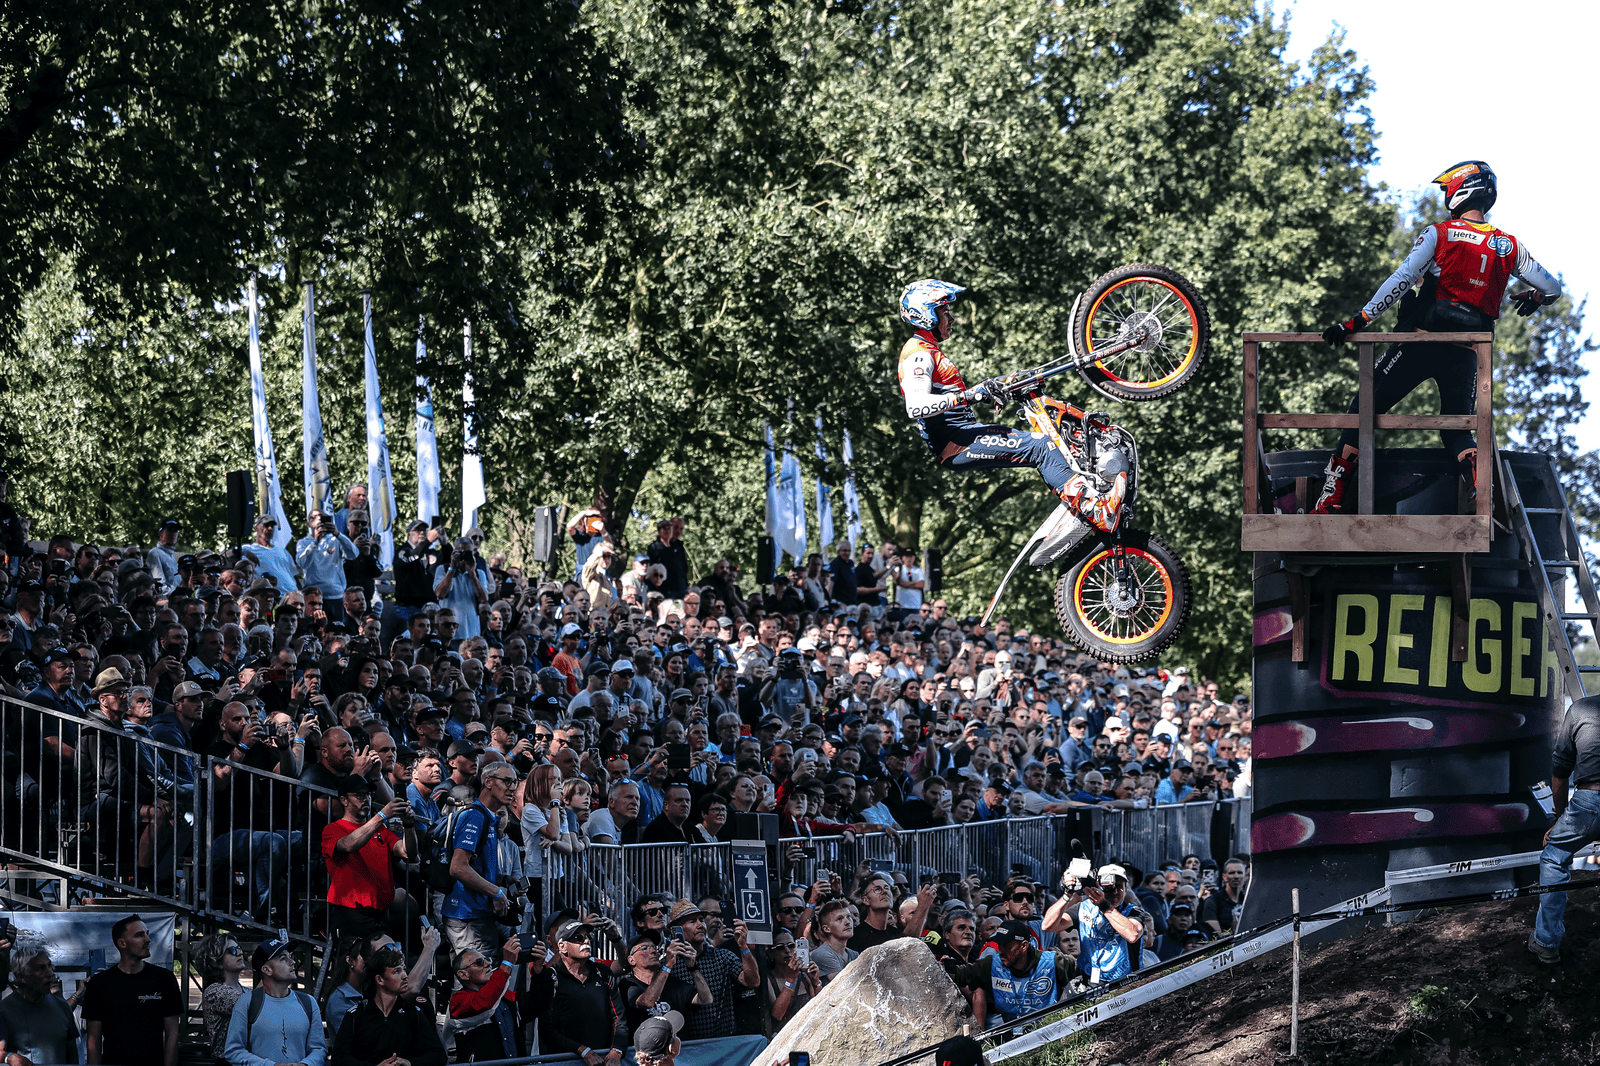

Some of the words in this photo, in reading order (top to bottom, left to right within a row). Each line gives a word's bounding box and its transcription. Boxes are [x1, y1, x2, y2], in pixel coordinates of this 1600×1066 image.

[1453, 230, 1478, 241] Hertz
[1480, 253, 1488, 274] 1
[973, 434, 1023, 449] repsol
[965, 451, 996, 460] hebo
[1210, 950, 1235, 970] FIM
[995, 979, 1013, 990] Hert
[1005, 997, 1044, 1006] MEDIA
[1076, 1006, 1100, 1026] FIM
